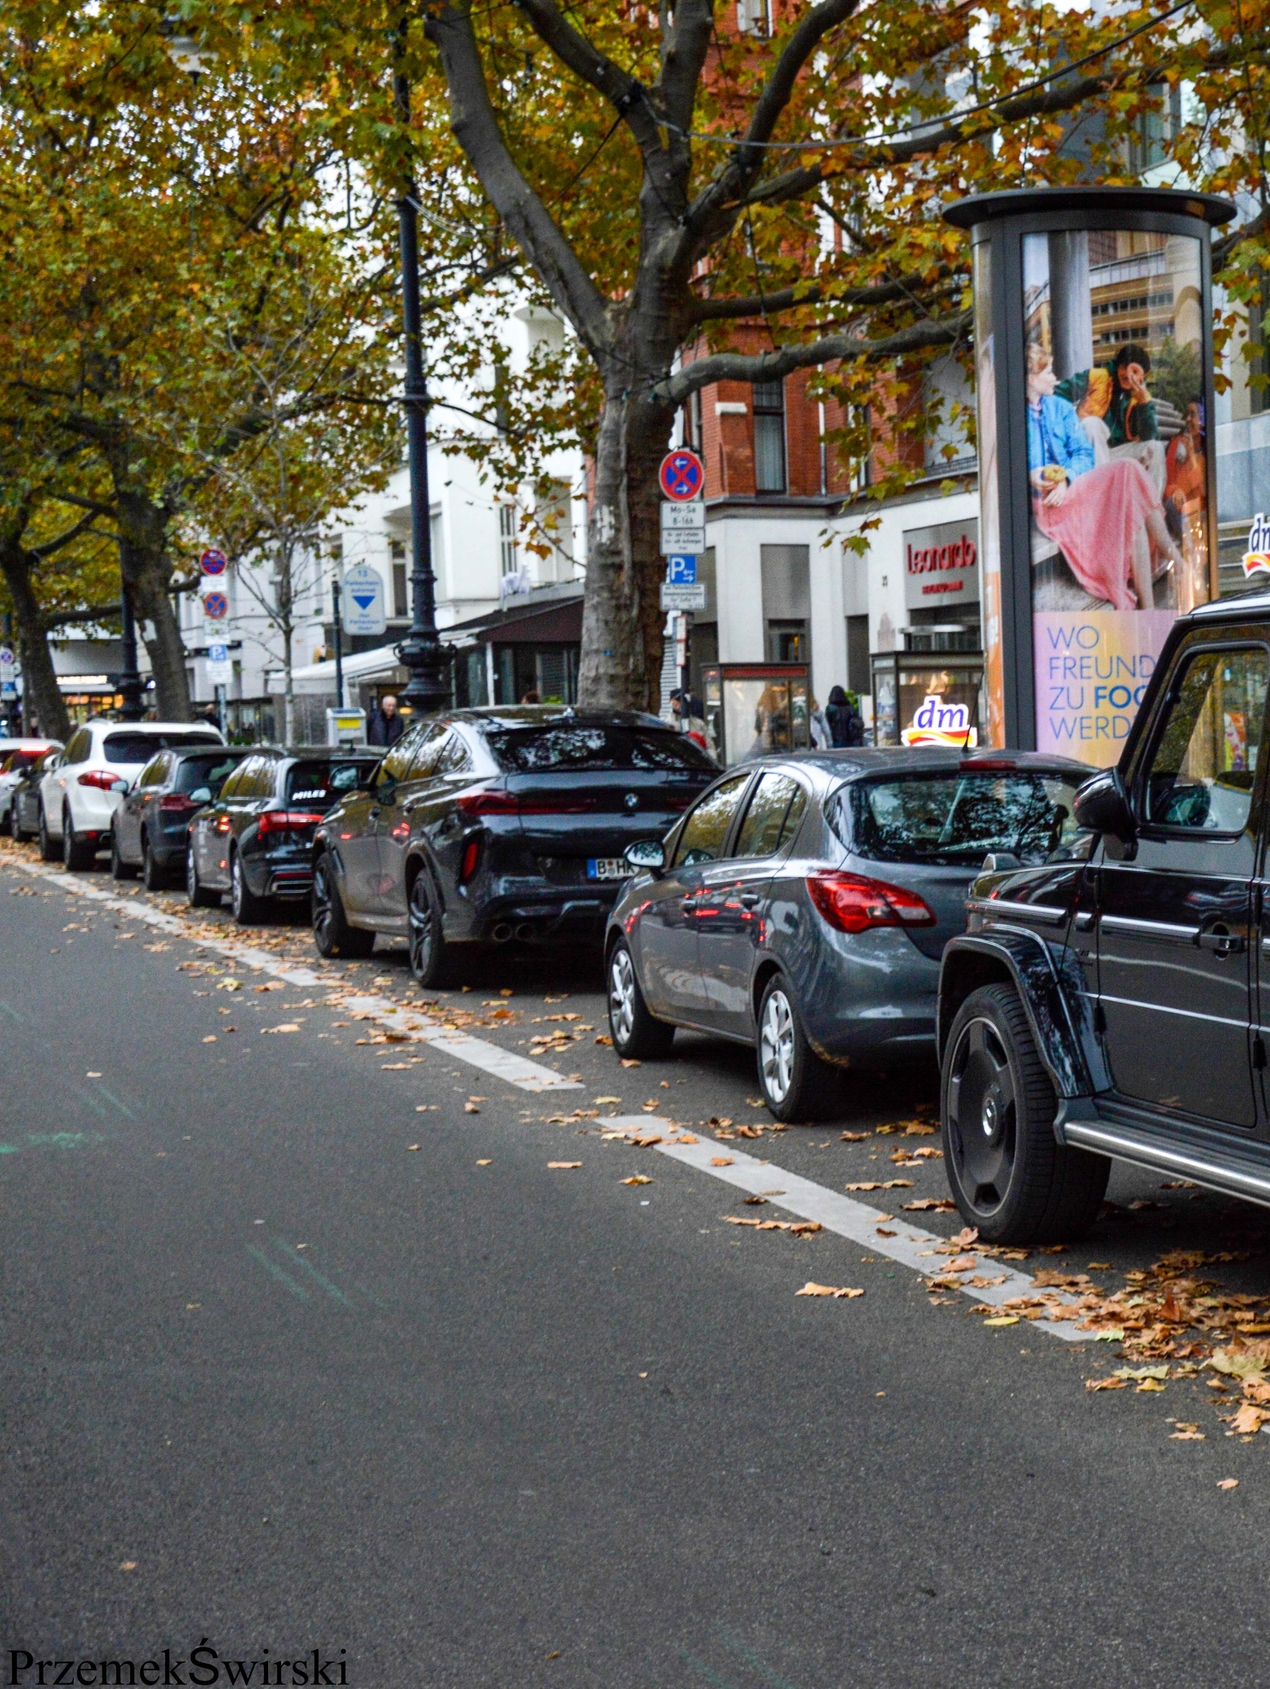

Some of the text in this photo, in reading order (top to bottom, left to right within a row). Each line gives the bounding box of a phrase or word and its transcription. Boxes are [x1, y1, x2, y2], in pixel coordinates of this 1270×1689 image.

[907, 534, 977, 575] Leonardo
[671, 557, 685, 580] P
[1047, 625, 1100, 650] WO
[1049, 654, 1156, 680] FREUND
[1049, 686, 1085, 711] ZU
[917, 700, 964, 729] dm
[1049, 714, 1137, 740] WERD
[292, 789, 327, 800] MILES
[597, 861, 606, 874] B
